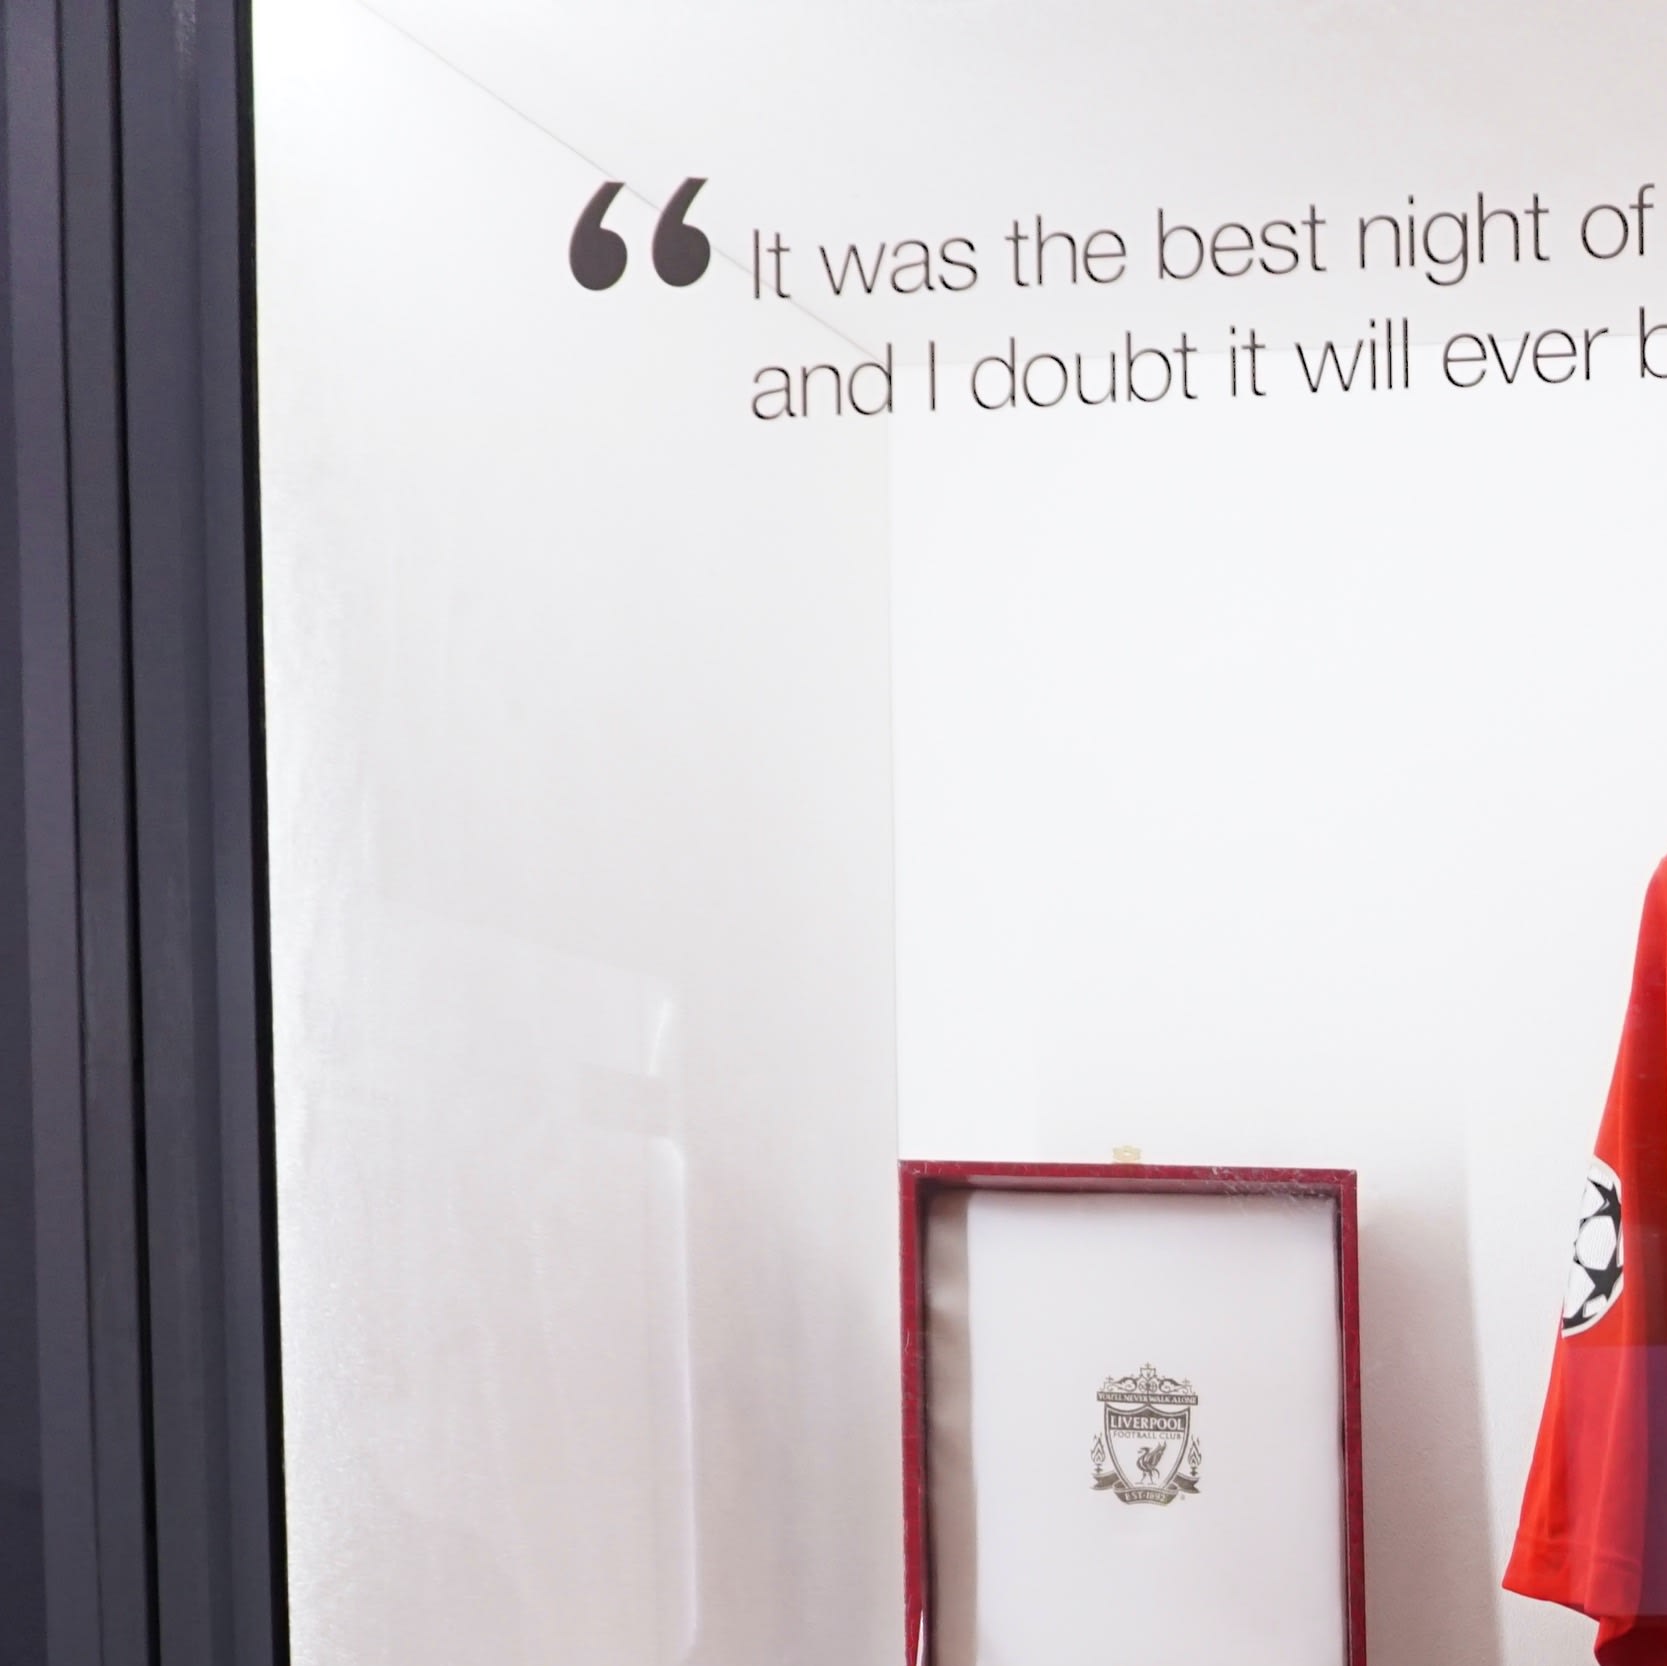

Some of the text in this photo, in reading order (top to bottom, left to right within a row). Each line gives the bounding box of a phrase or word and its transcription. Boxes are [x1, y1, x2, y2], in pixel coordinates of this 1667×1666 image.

[752, 228, 793, 301] It
[817, 236, 979, 297] was
[1003, 213, 1128, 289] the
[1156, 203, 1328, 281] best
[1358, 190, 1551, 288] night
[1579, 182, 1656, 261] of
[750, 341, 894, 422] and
[928, 339, 937, 413] I
[969, 329, 1199, 411] doubt
[1228, 324, 1268, 398] it
[1293, 316, 1410, 395] will
[1442, 326, 1610, 389] ever
[1110, 1415, 1185, 1431] LIVERPOOL
[1113, 1430, 1182, 1440] FOOTBALL CLUB
